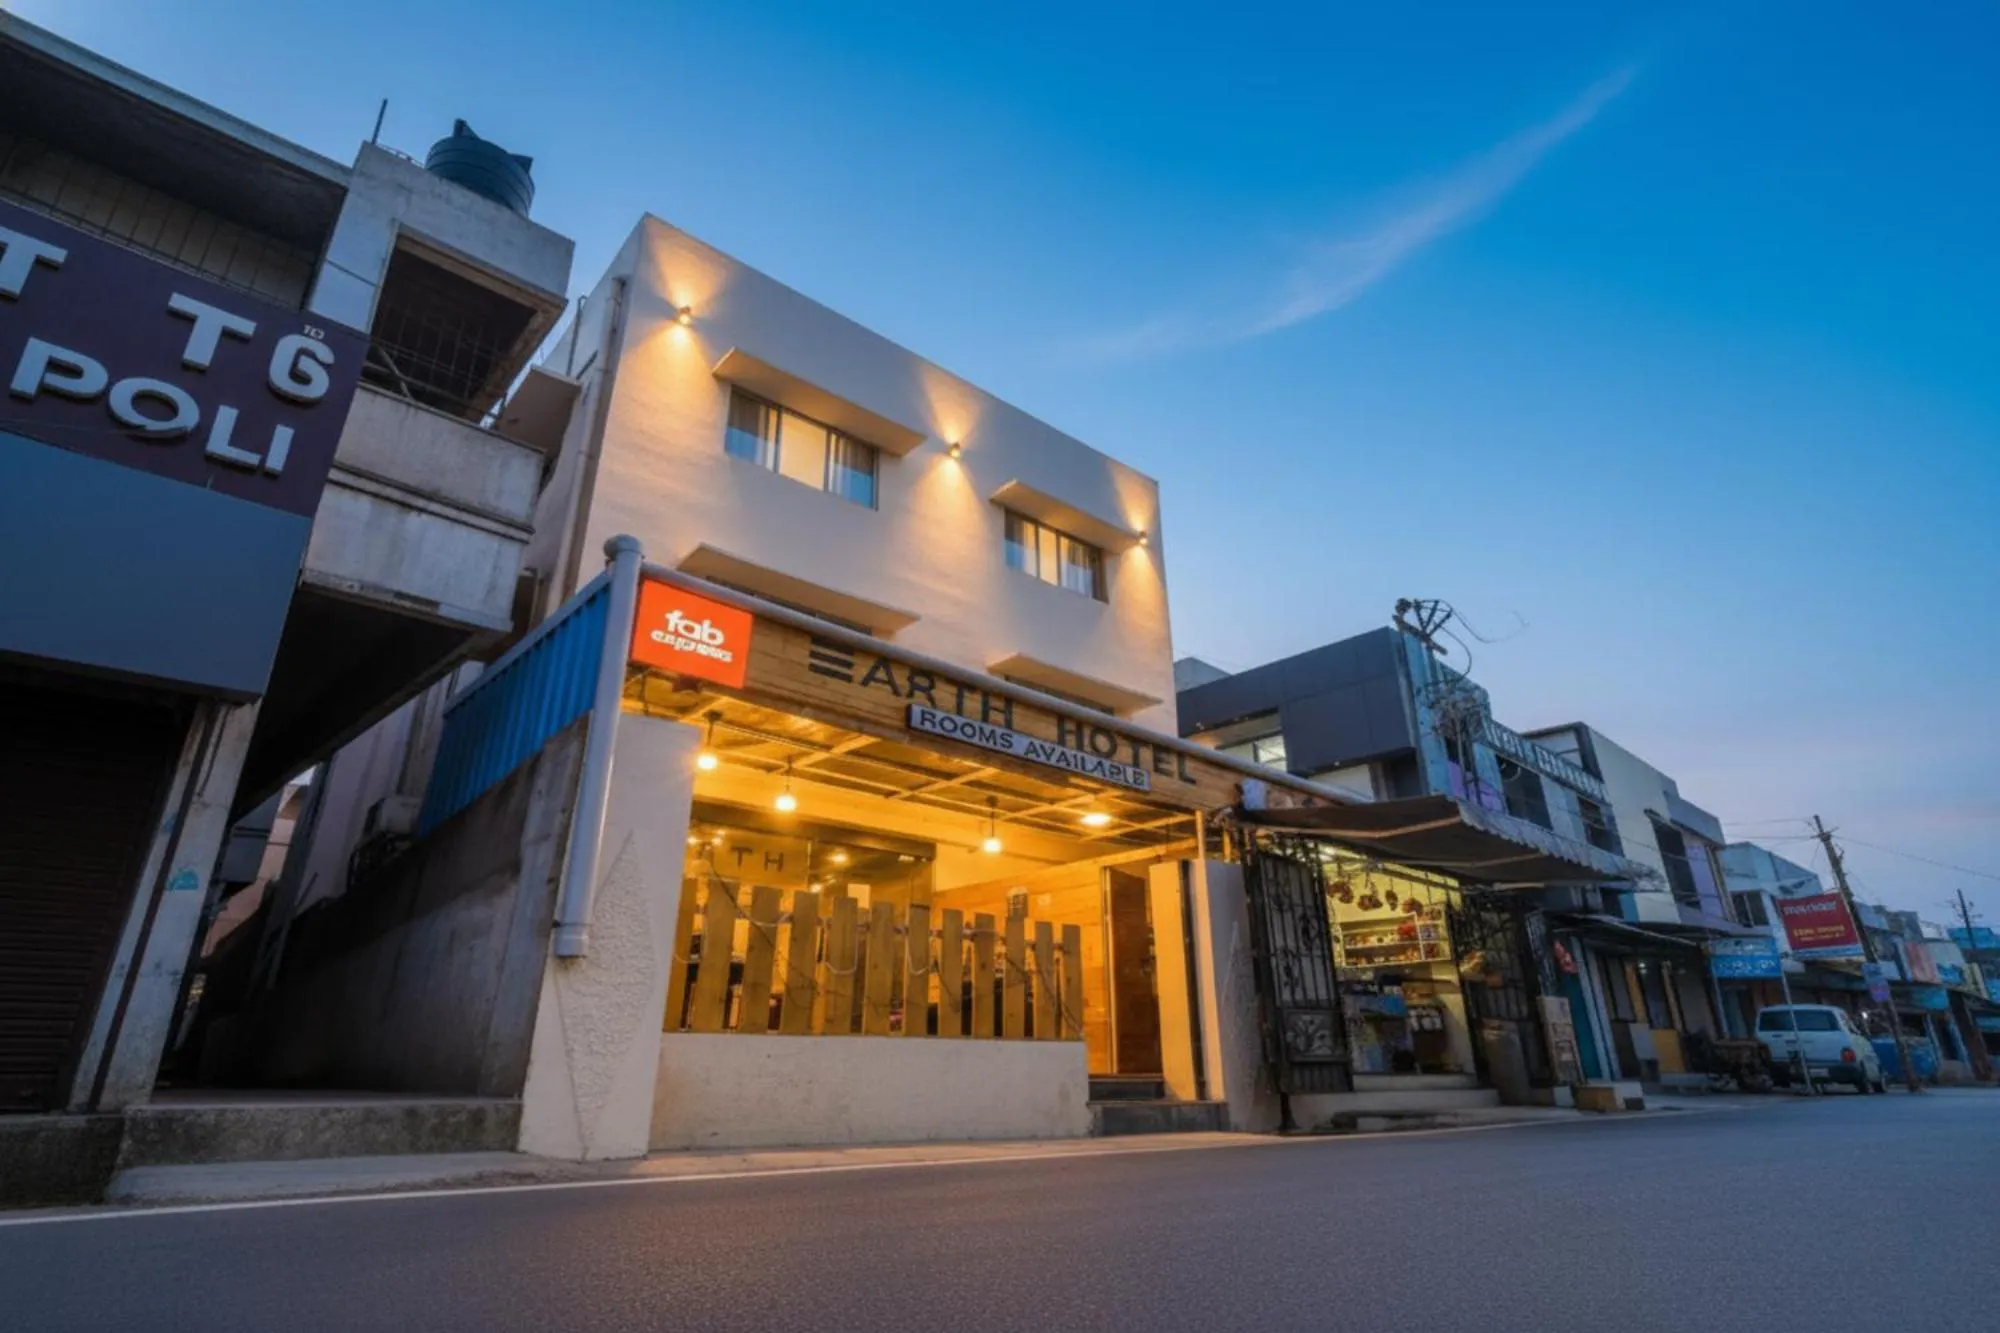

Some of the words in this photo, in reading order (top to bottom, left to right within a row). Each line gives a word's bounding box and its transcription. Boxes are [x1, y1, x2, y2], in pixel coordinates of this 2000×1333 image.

[10, 336, 295, 475] POLI
[665, 609, 725, 646] fab
[808, 636, 1013, 730] EARTH
[1057, 713, 1197, 784] HOTEL
[920, 708, 1014, 750] ROOMS
